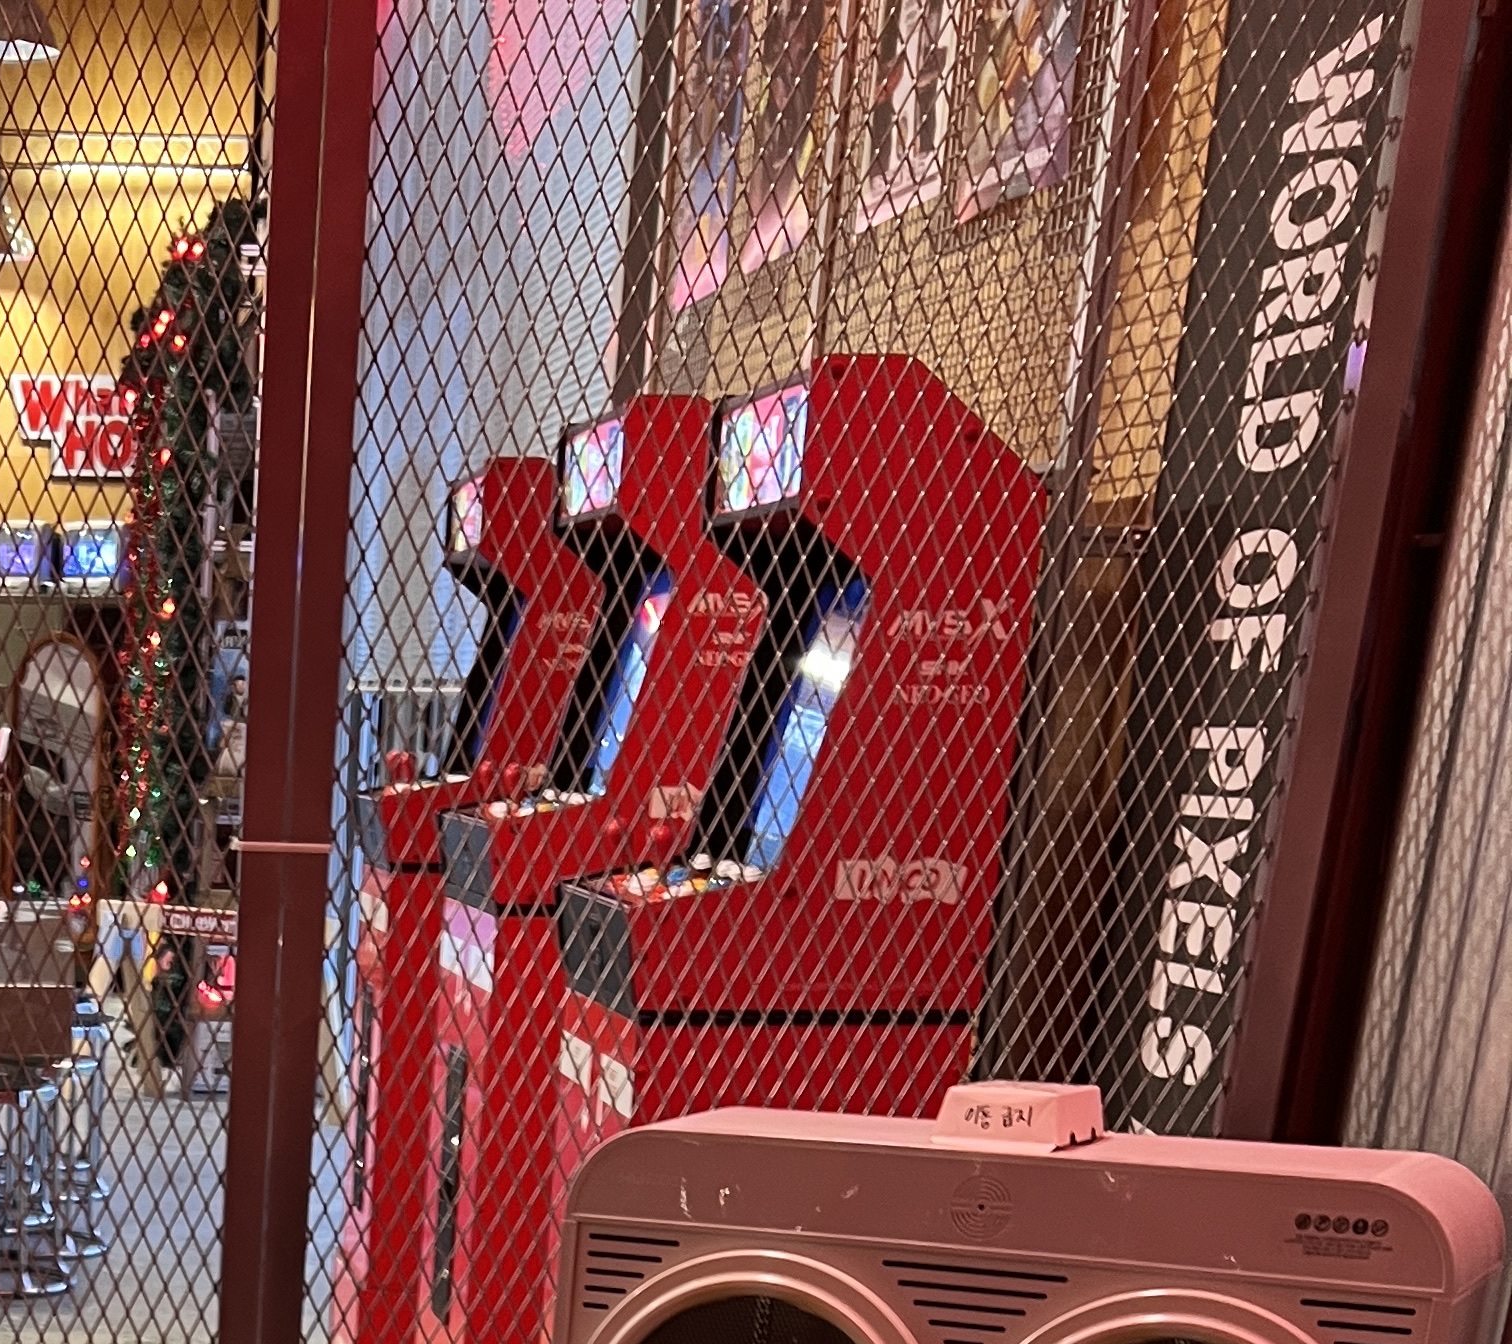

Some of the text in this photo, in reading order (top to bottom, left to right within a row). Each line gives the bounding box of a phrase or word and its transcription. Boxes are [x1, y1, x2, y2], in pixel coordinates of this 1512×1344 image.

[1140, 13, 1385, 1086] WORLD OF PIXELS
[964, 1105, 992, 1130] 이동
